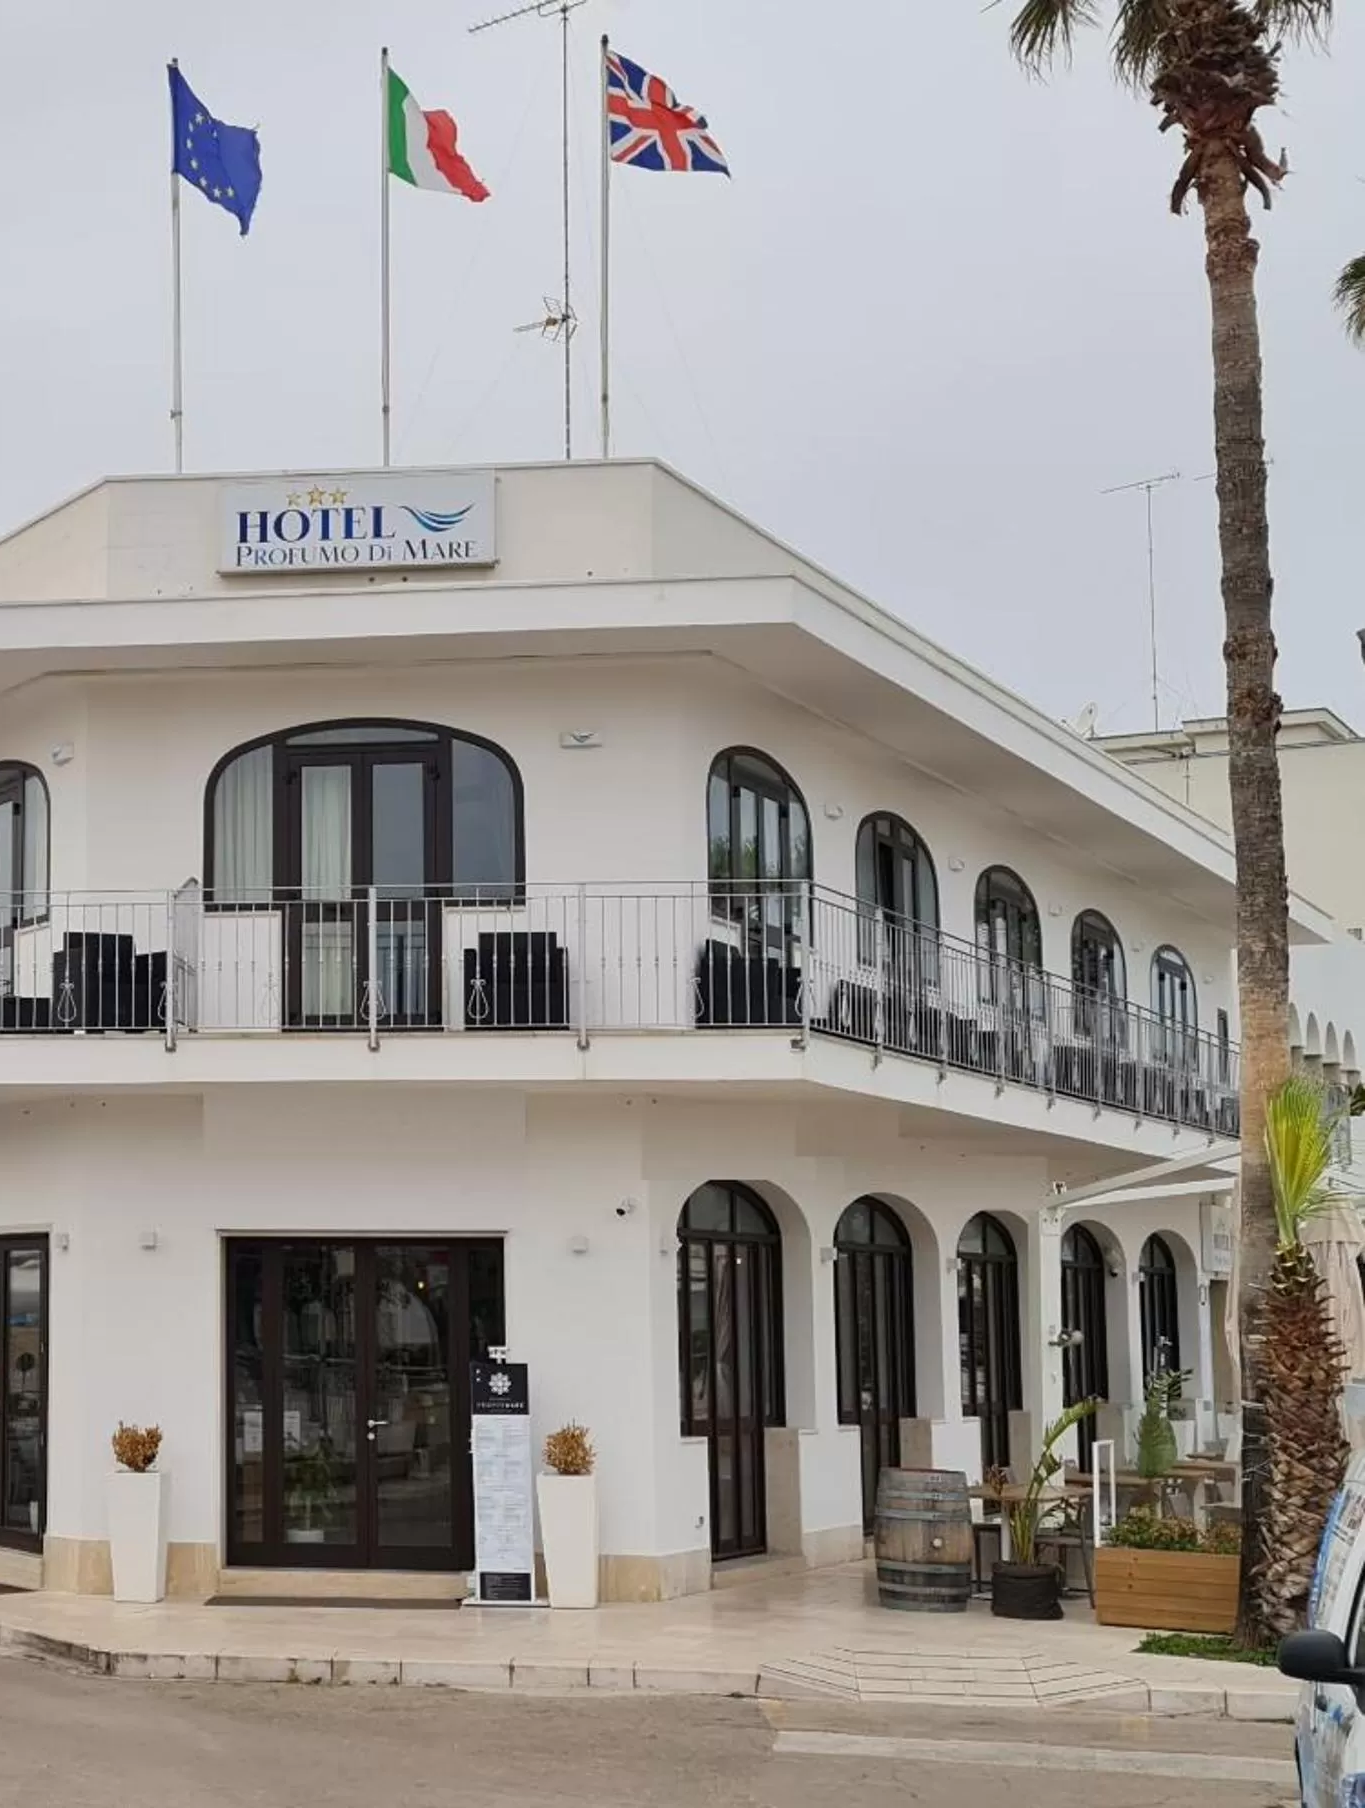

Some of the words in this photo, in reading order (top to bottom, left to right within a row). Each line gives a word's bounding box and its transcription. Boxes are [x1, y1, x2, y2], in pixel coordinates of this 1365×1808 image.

[237, 505, 396, 544] HOTEL
[236, 545, 360, 567] PROFUMO
[402, 538, 478, 561] MARE
